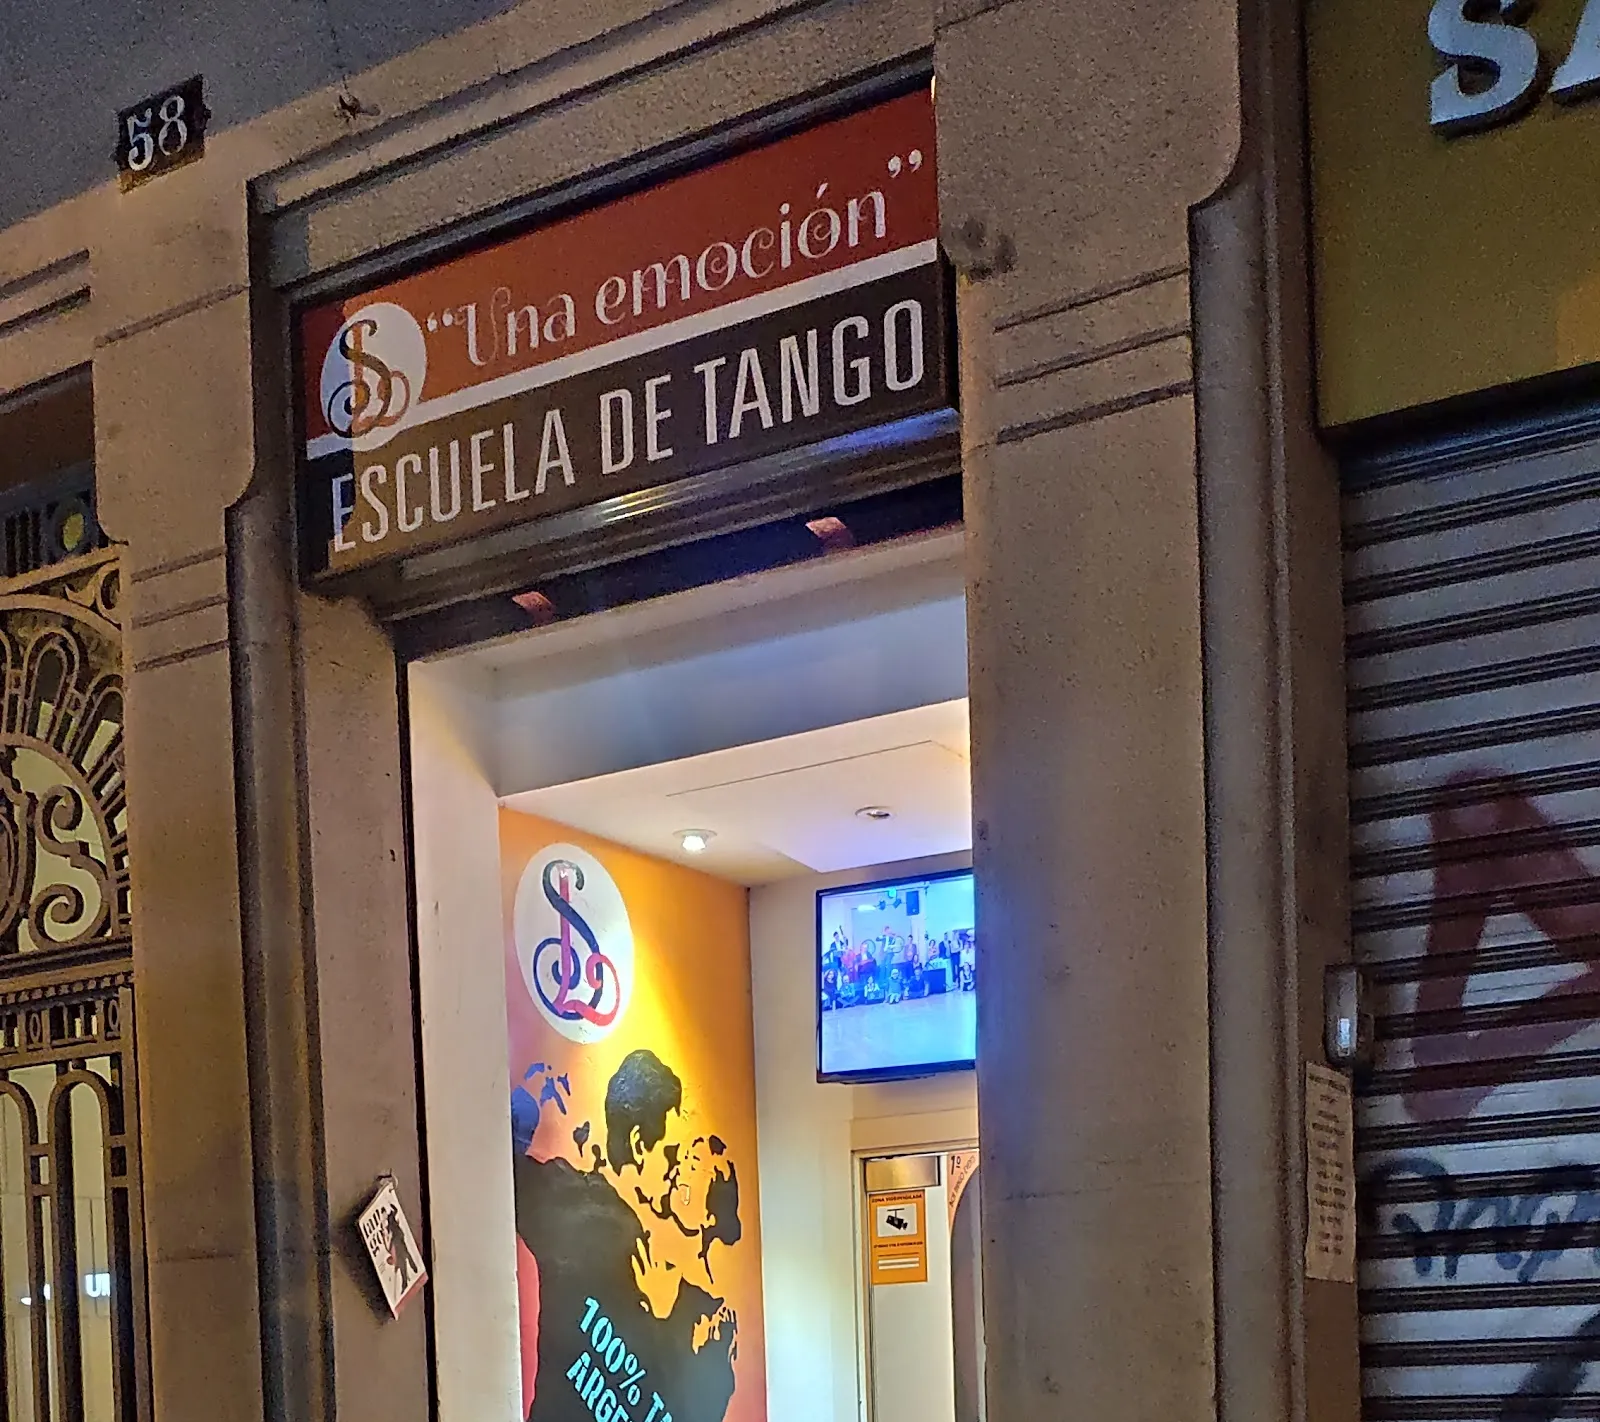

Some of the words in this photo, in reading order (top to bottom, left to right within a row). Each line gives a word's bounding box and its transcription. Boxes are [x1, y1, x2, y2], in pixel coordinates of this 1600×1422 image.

[1427, 0, 1600, 125] S
[127, 95, 188, 171] 58
[331, 408, 576, 553] ESCUELA
[599, 374, 674, 476] DE
[694, 299, 924, 446] TANGO
[577, 1296, 647, 1406] 100%
